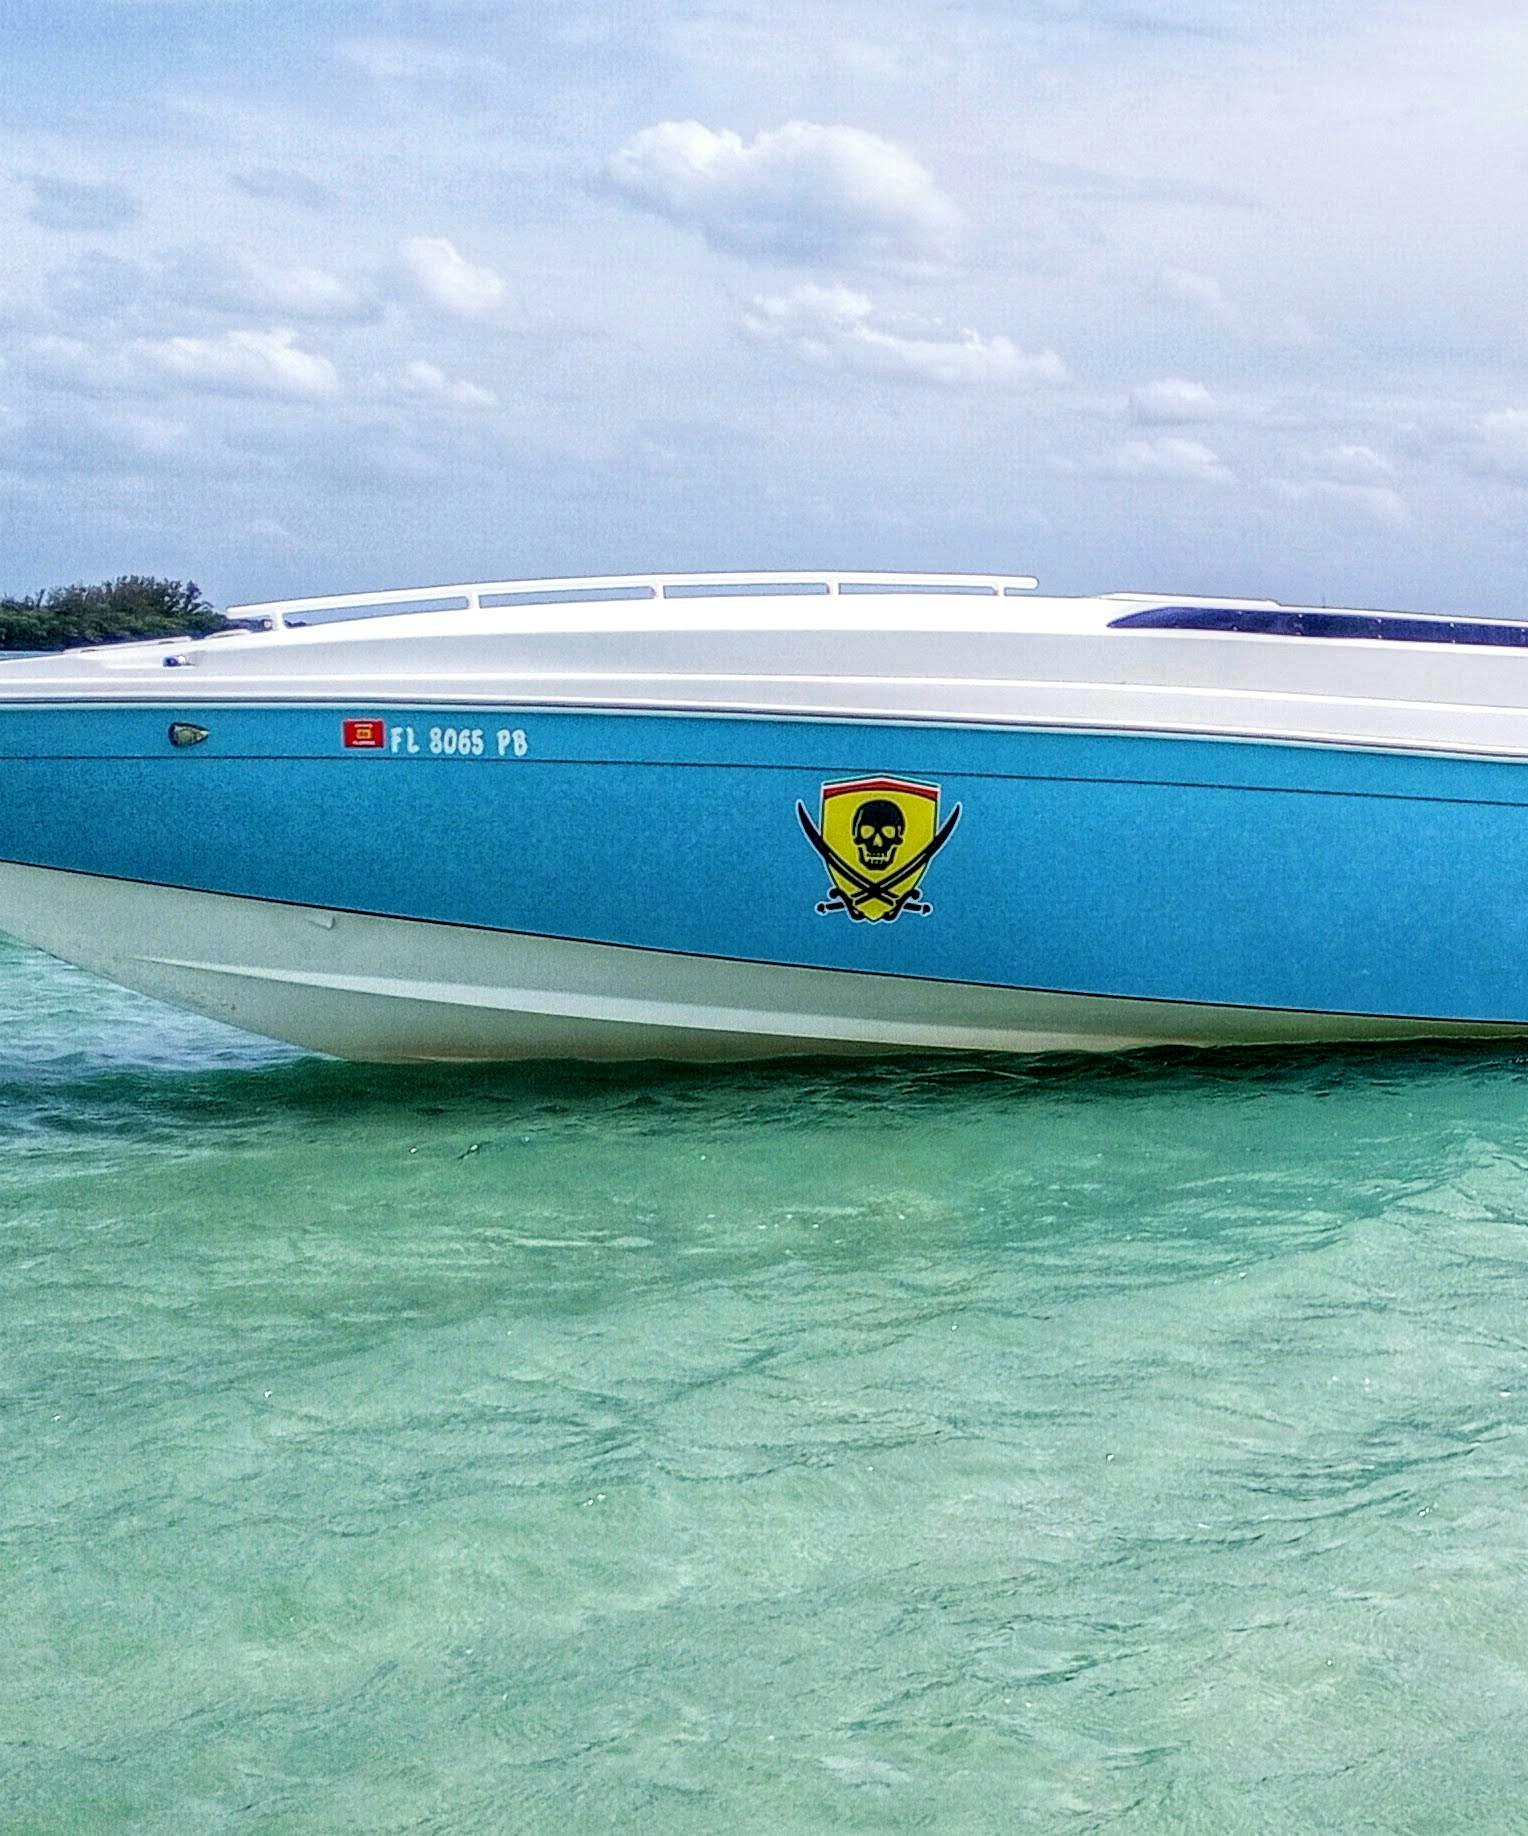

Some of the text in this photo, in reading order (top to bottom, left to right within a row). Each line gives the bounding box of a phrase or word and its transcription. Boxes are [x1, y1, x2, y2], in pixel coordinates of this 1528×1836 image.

[390, 726, 528, 757] FL 8065 PB
